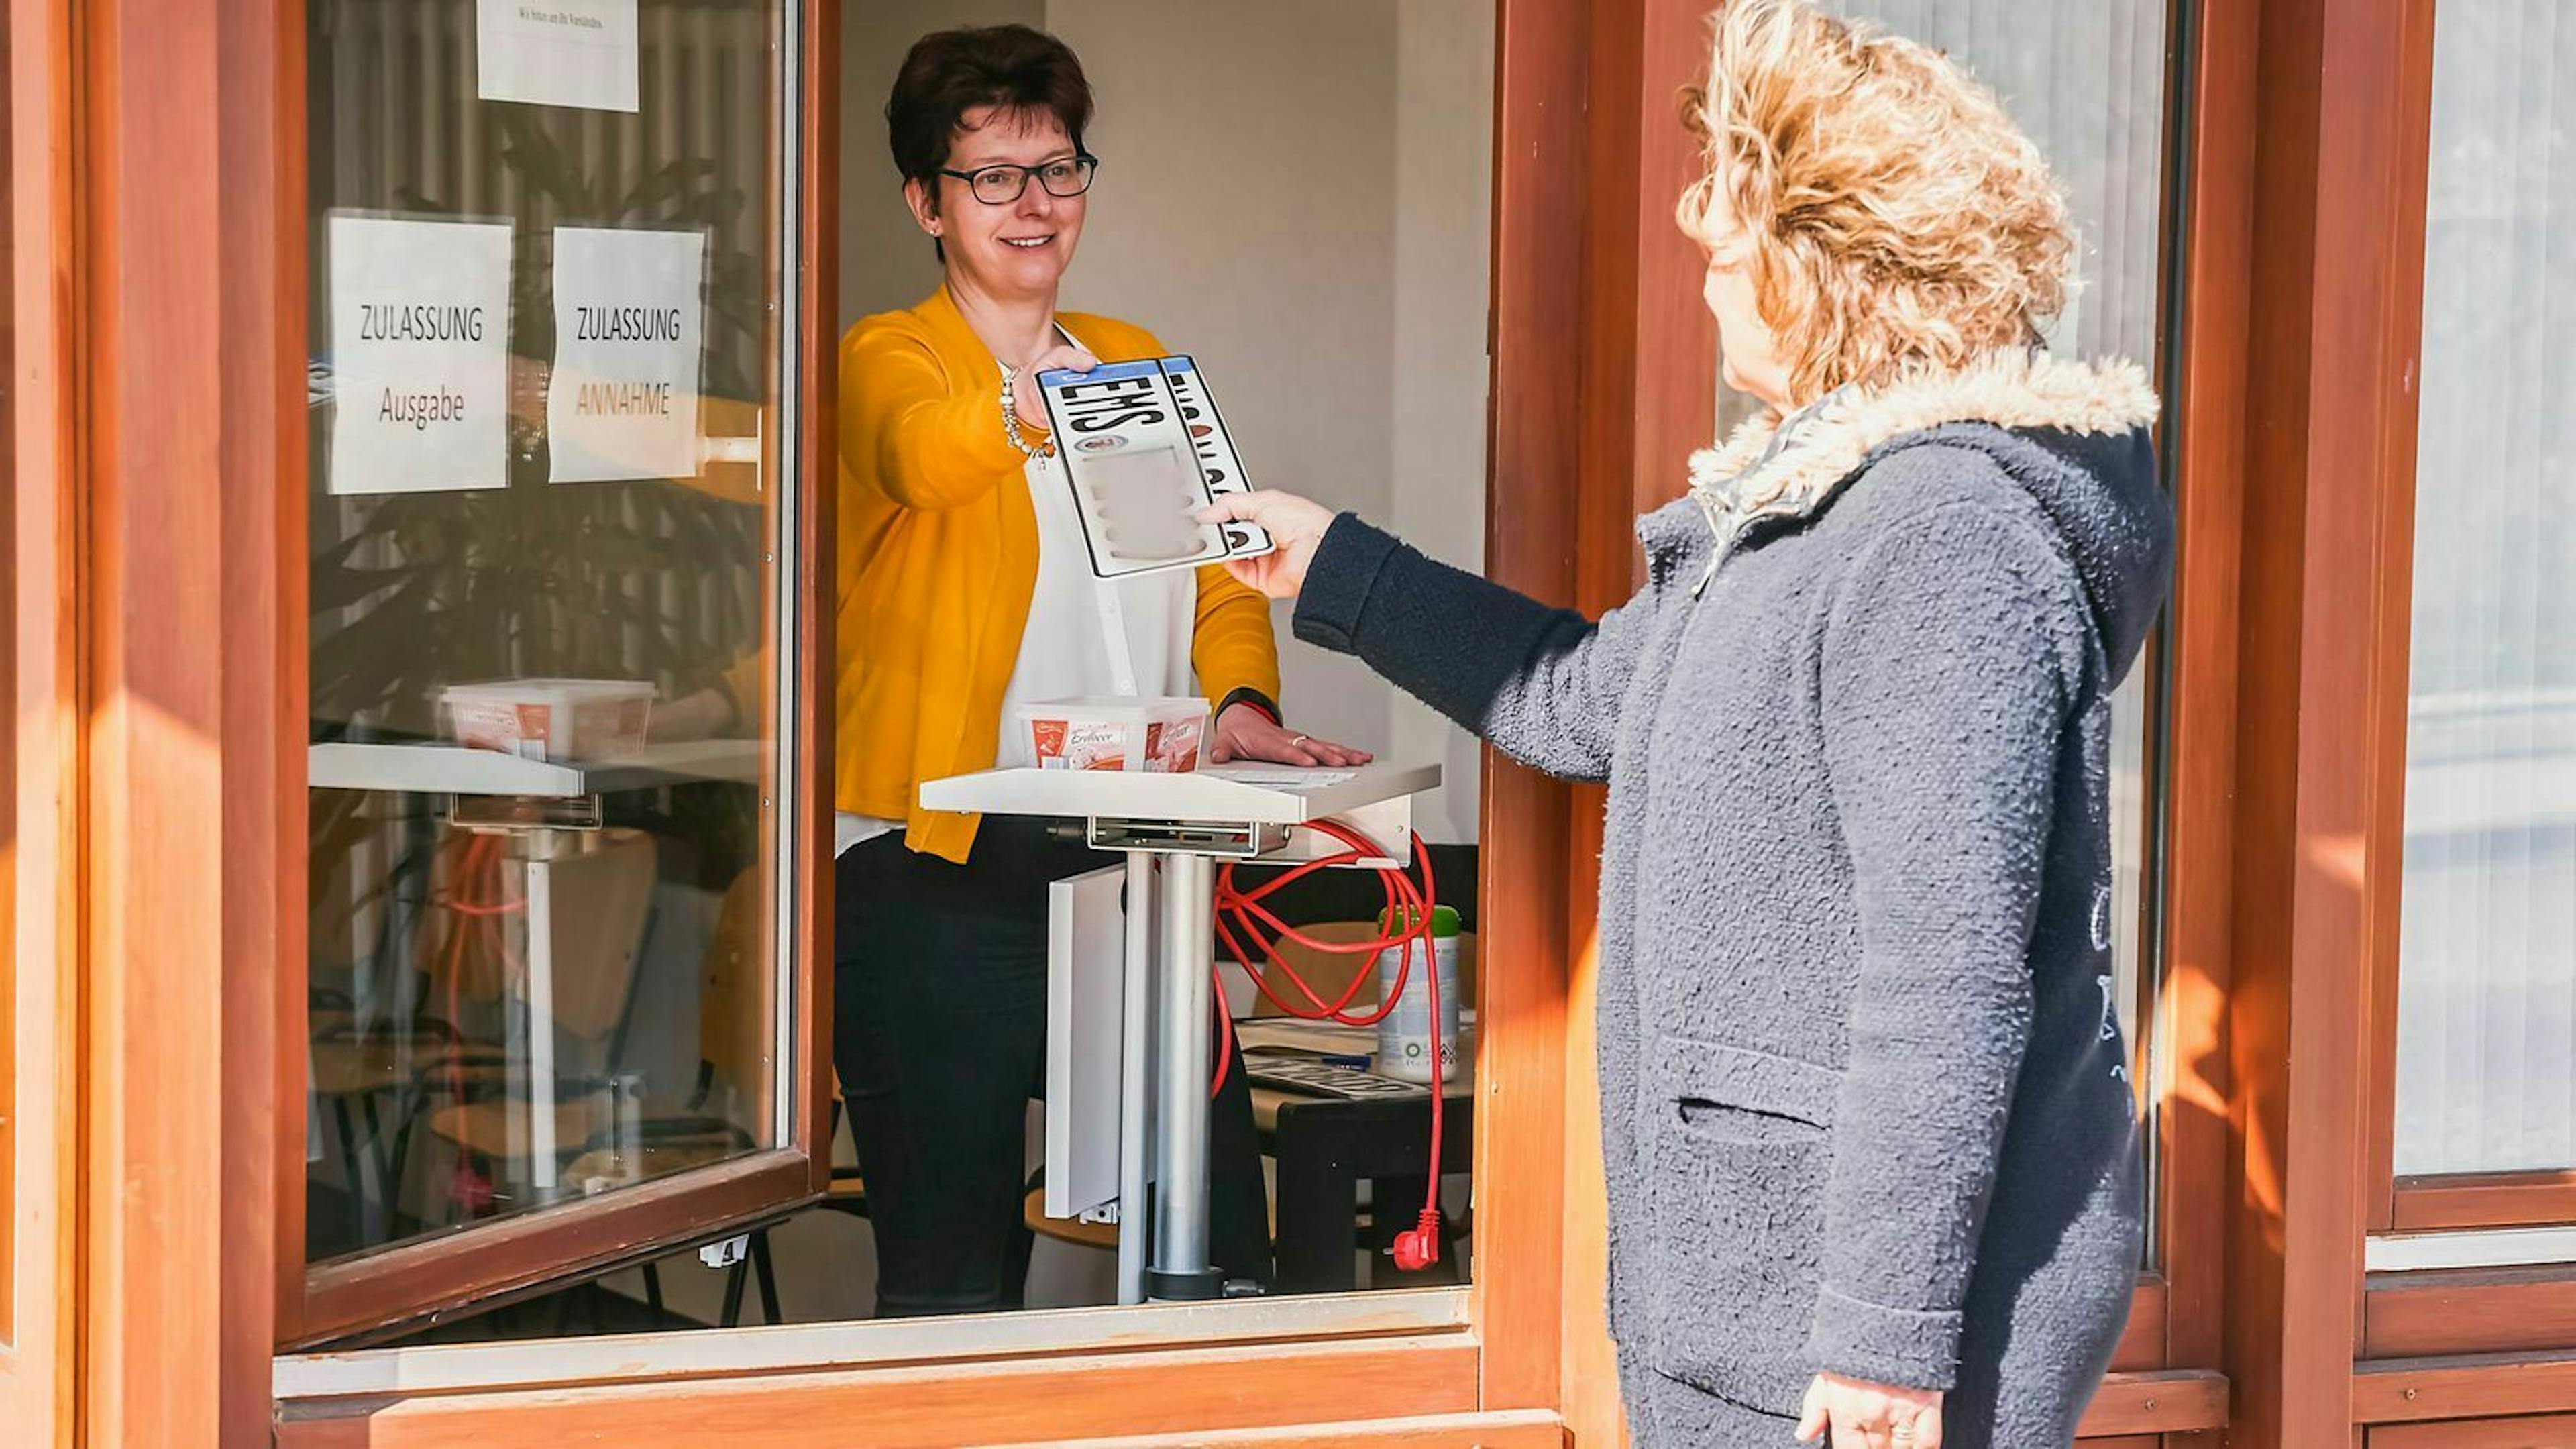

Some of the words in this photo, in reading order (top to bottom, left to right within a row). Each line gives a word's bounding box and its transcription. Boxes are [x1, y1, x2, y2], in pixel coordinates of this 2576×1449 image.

[360, 303, 483, 341] ZULASSUNG
[576, 307, 680, 341] ZULASSUNG
[379, 384, 464, 431] Ausgabe
[576, 382, 671, 415] ANNAHME
[1060, 377, 1165, 433] EMS
